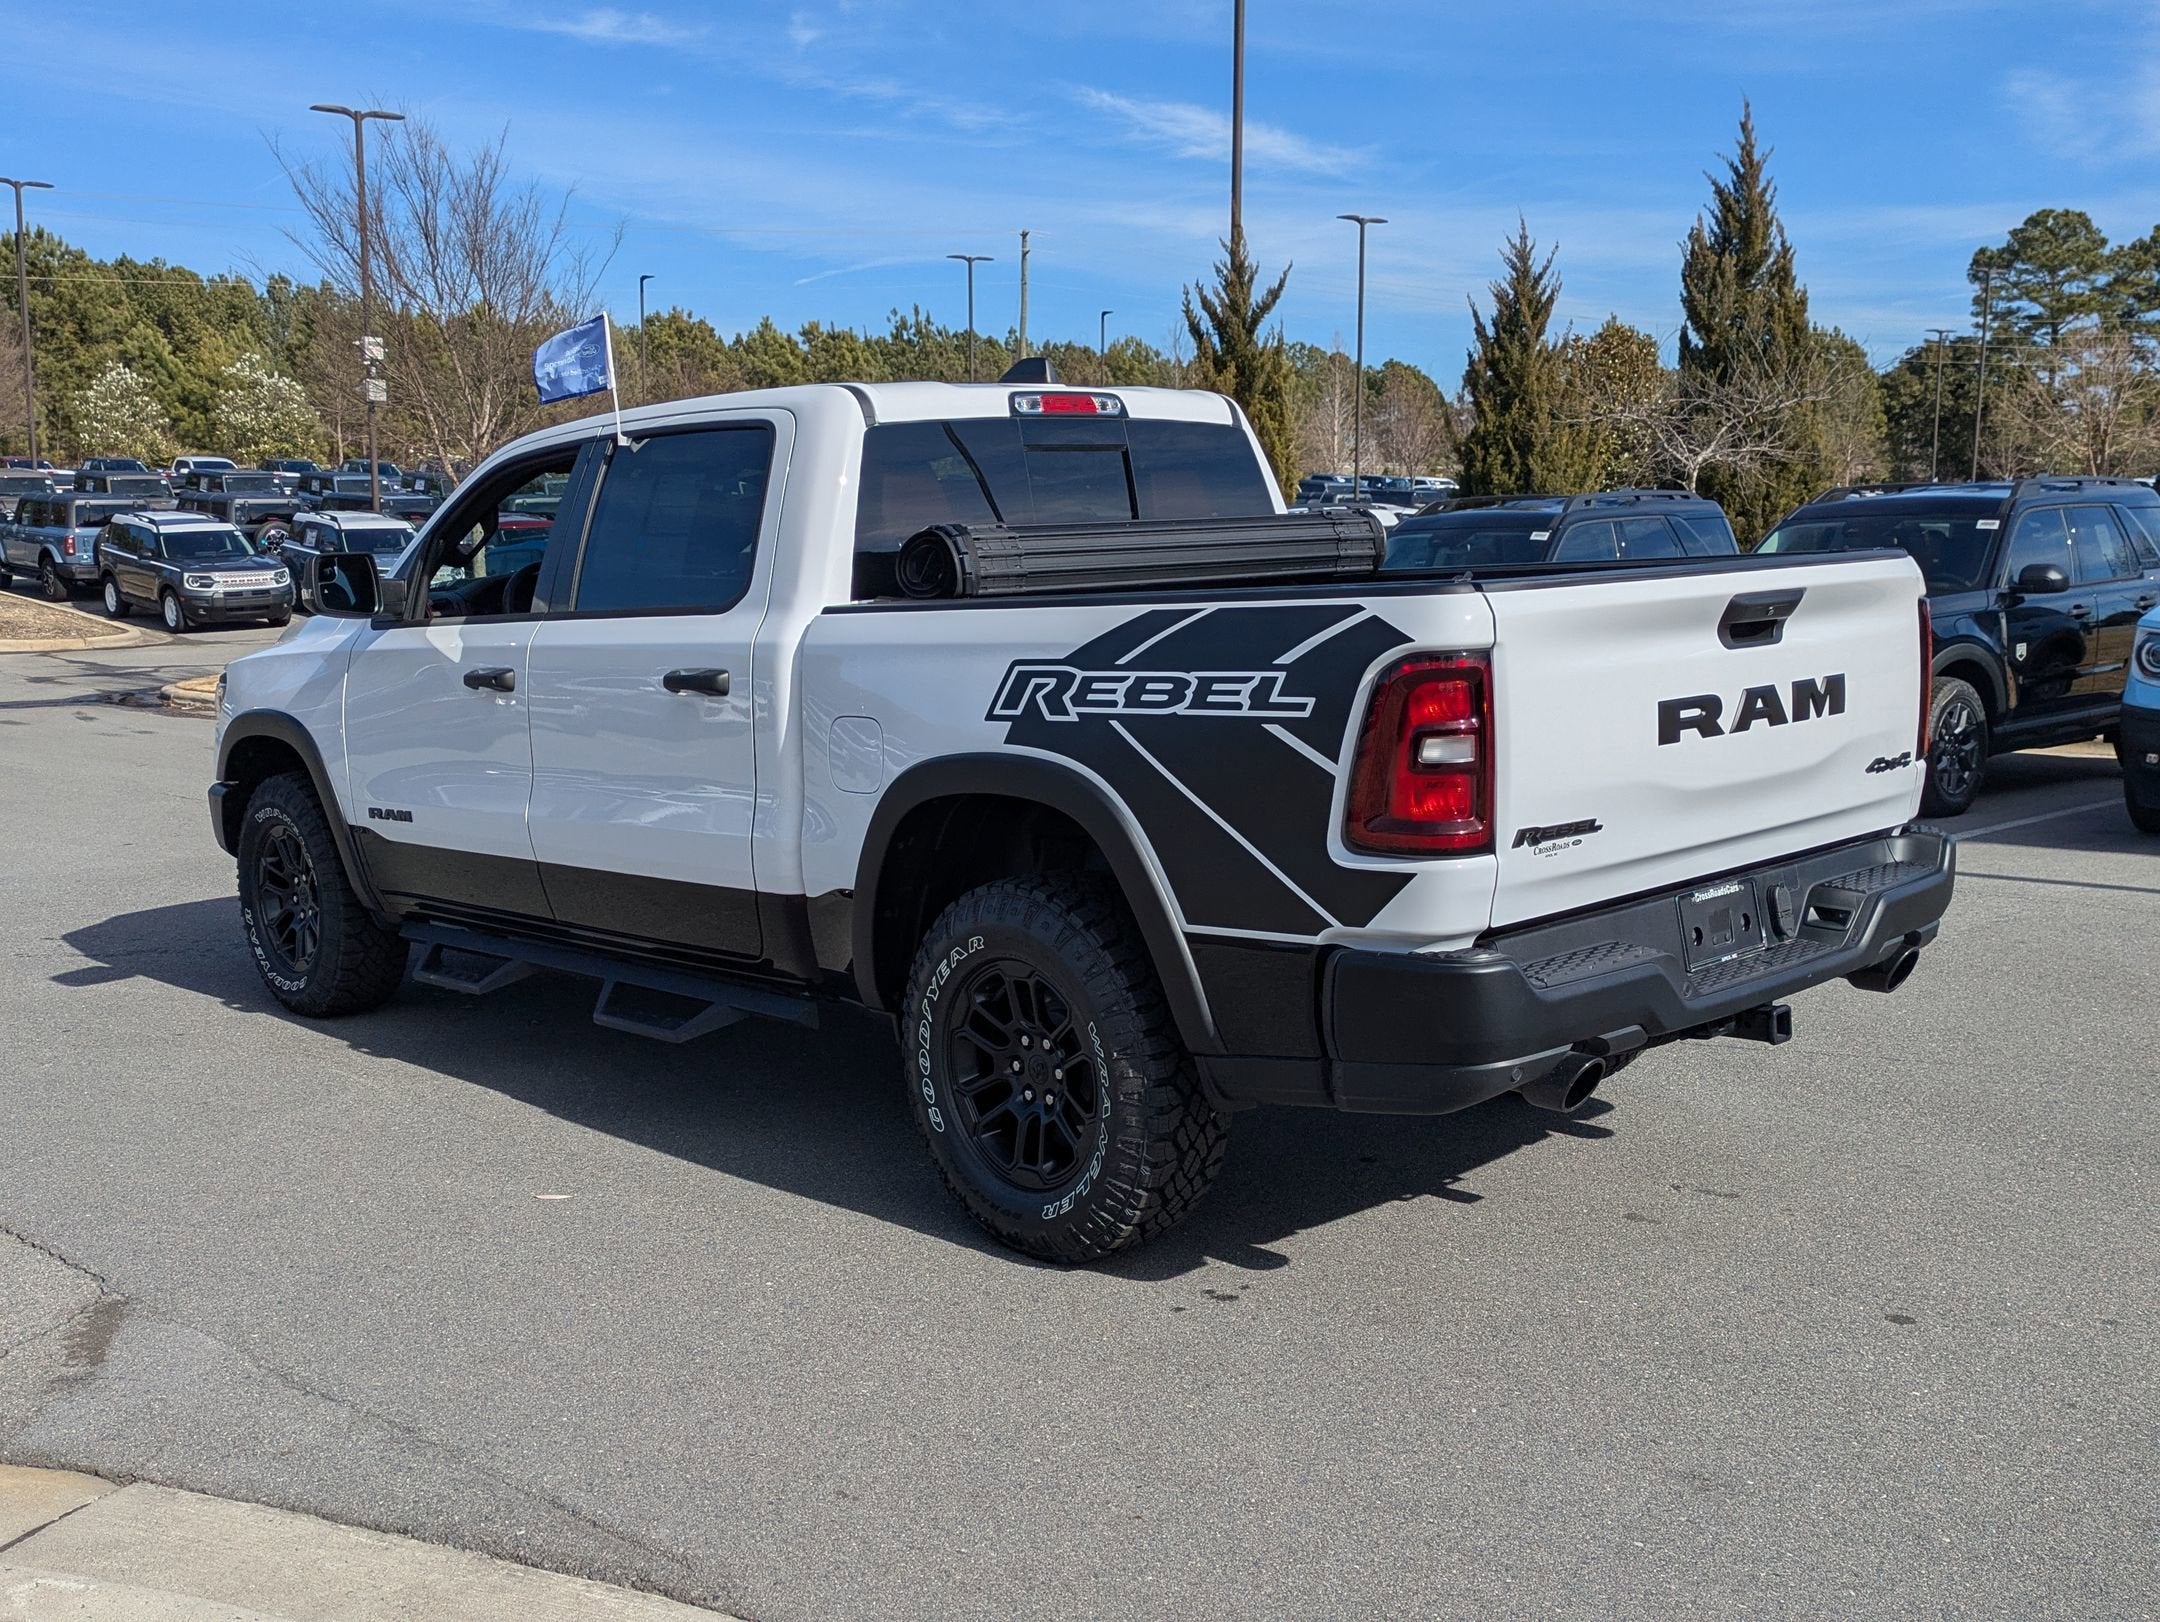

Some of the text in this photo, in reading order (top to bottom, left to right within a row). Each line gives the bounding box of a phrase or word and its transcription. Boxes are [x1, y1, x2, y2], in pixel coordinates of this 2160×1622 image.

[993, 666, 1316, 721] REBEL
[1658, 673, 1845, 746] RAM
[368, 807, 413, 822] RAM
[1512, 818, 1603, 849] REBEL
[244, 907, 308, 991] GOODYEAR
[919, 936, 985, 1133] GOODYEAR
[1042, 1021, 1111, 1219] WRANGLER
